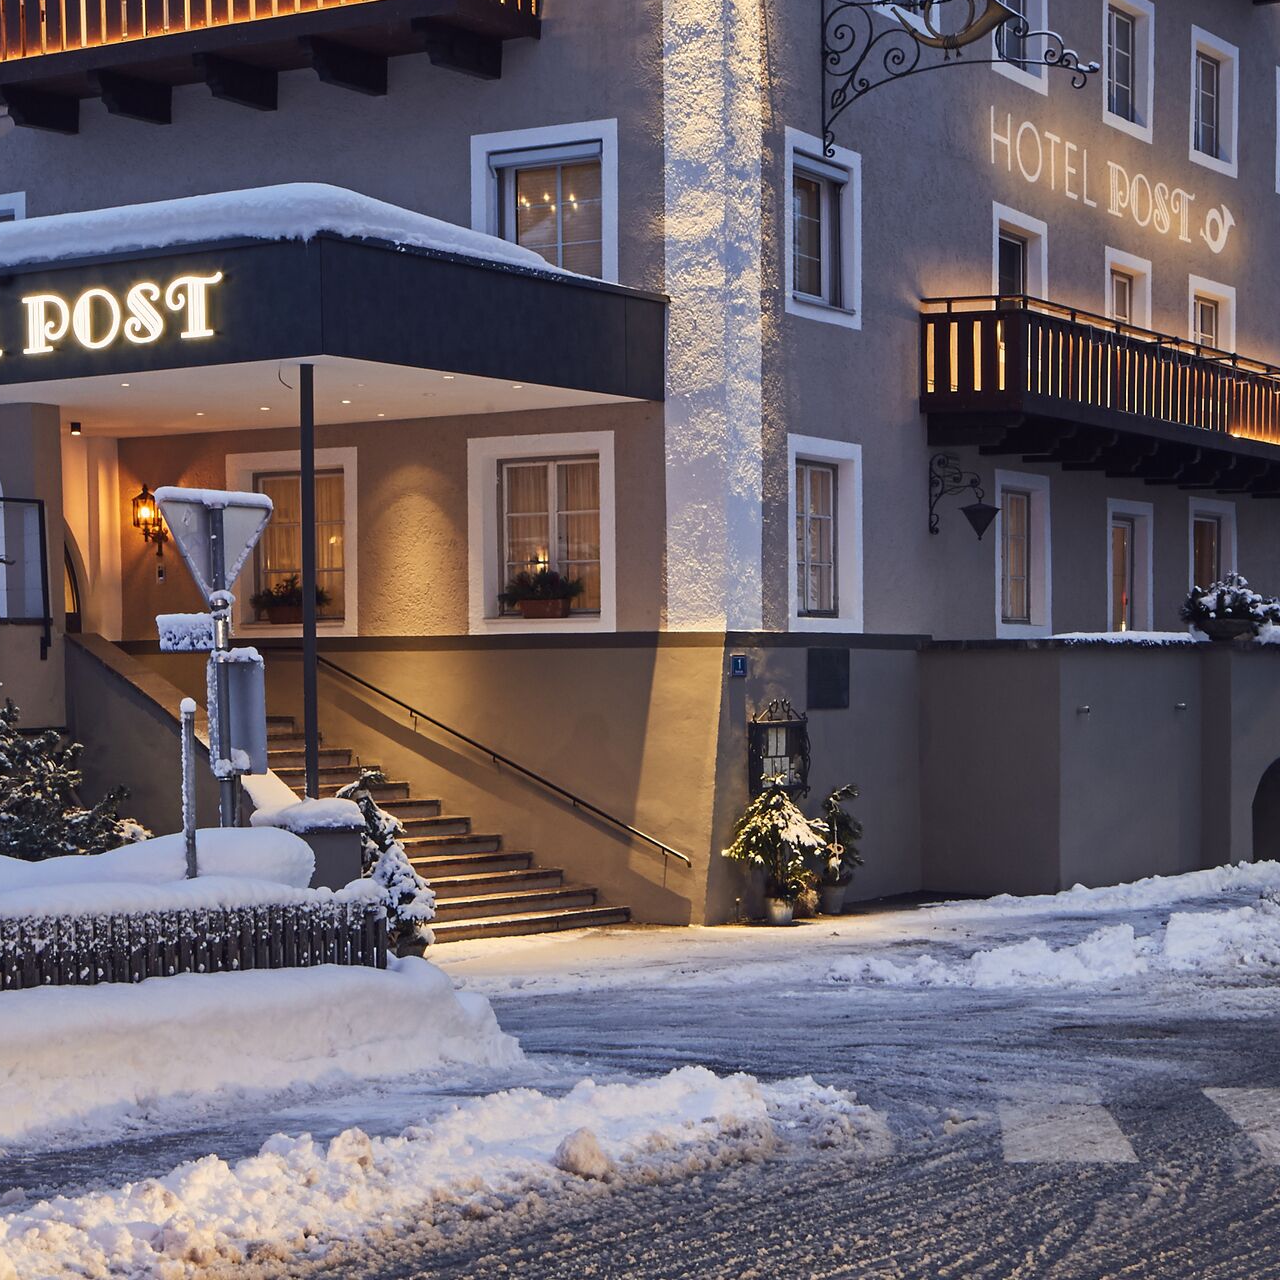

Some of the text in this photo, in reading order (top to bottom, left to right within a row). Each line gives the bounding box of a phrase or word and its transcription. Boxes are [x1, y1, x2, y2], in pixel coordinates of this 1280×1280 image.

[990, 105, 1195, 243] HOTEL POST
[21, 271, 222, 355] POST
